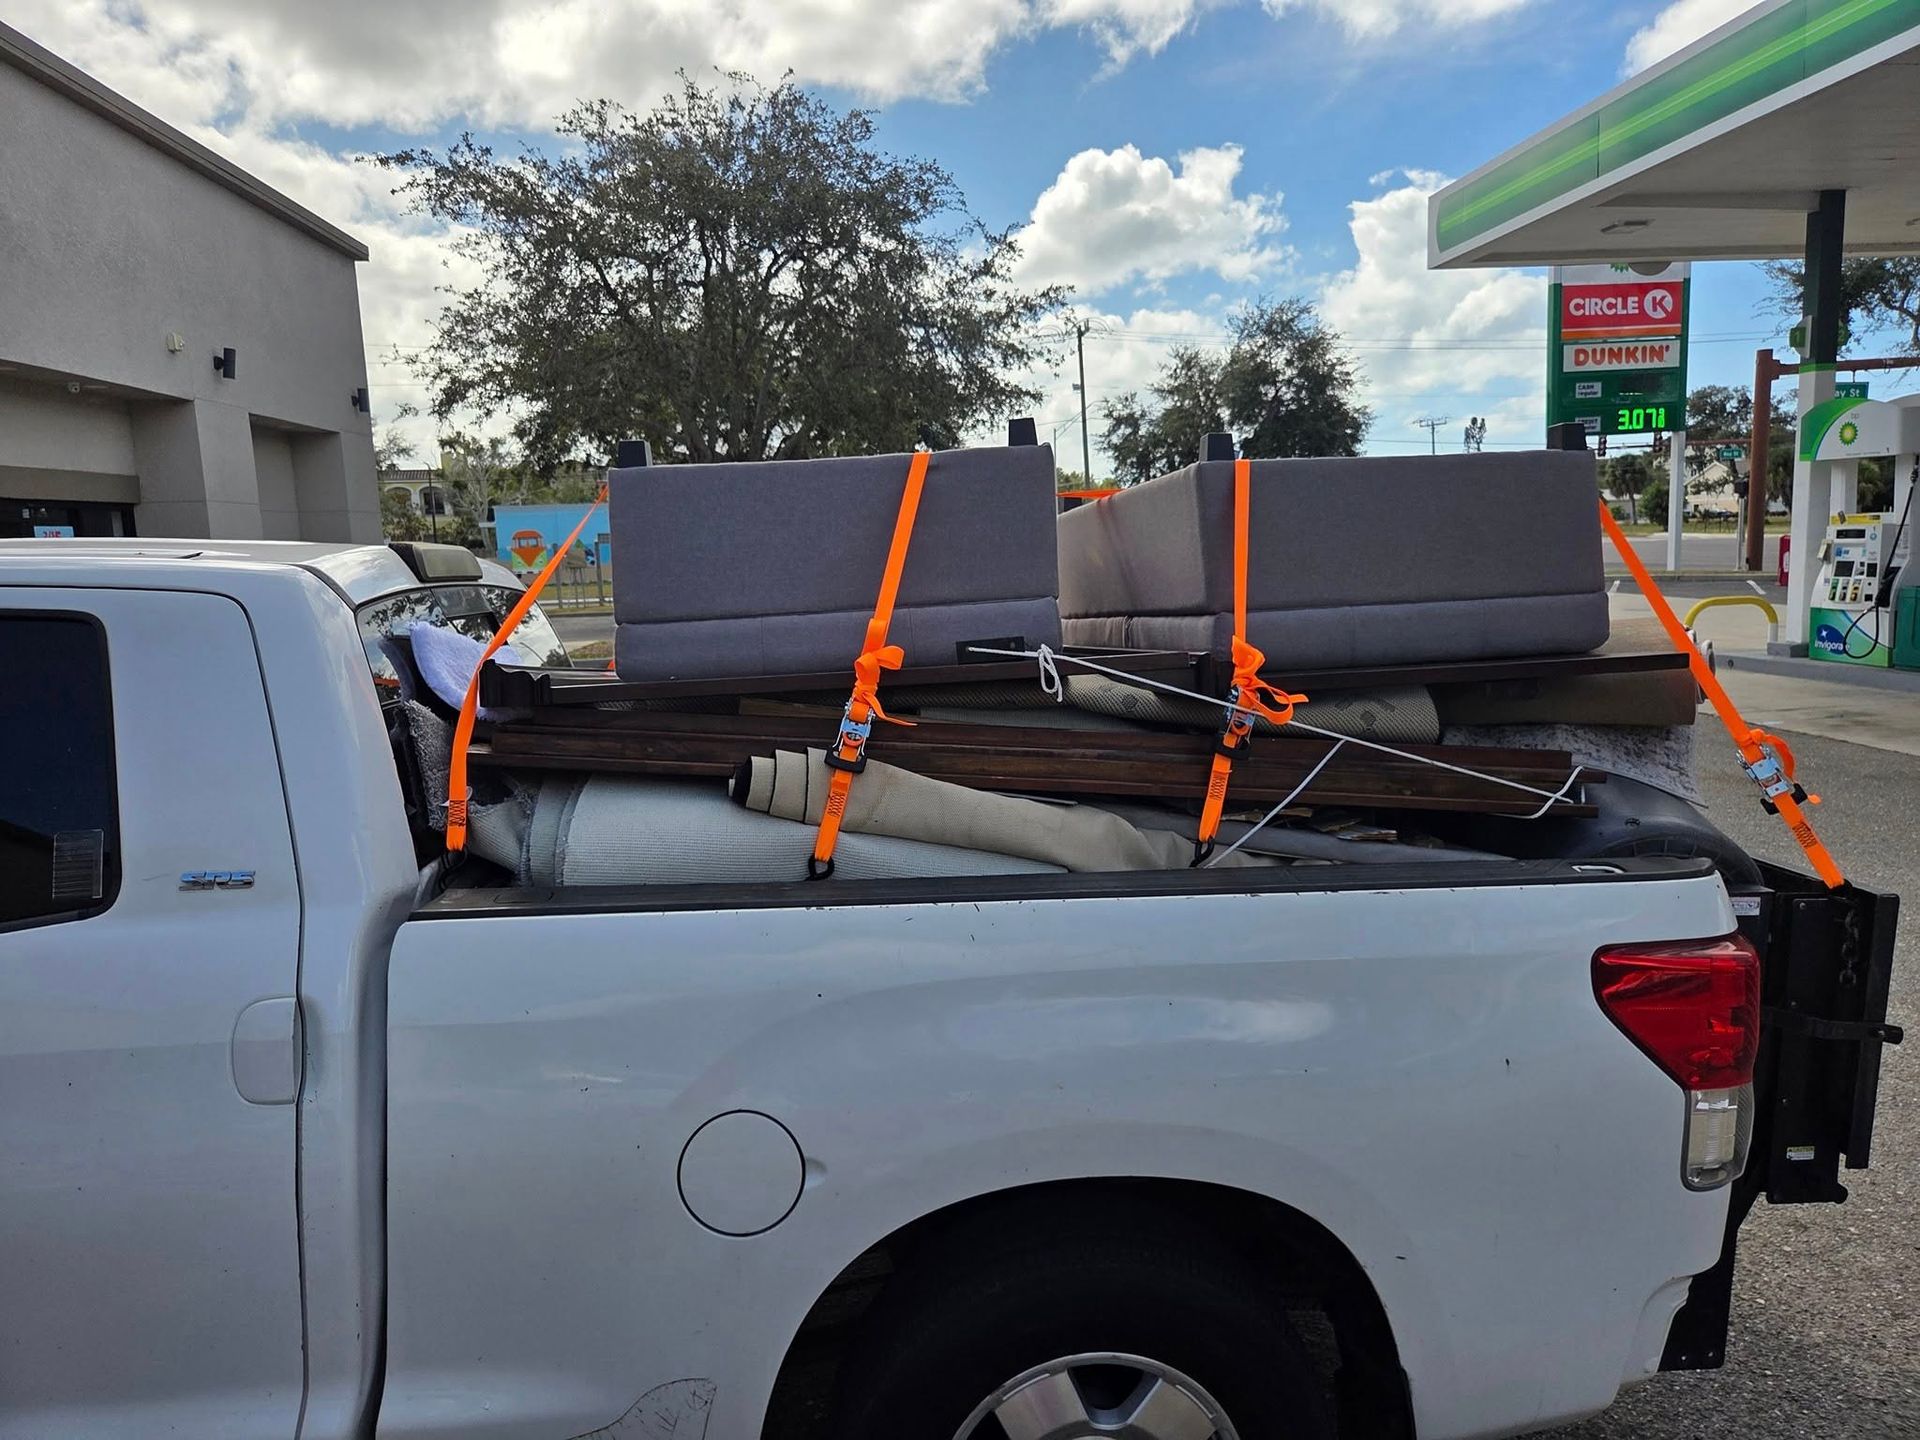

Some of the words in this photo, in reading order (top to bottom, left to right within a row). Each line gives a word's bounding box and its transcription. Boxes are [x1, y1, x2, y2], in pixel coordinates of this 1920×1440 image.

[1569, 296, 1639, 316] CIRCLE
[1648, 292, 1673, 318] K
[1574, 344, 1670, 367] DUNKIN'
[1834, 389, 1846, 399] ay
[1850, 388, 1860, 398] St
[1815, 640, 1850, 651] Invigorae
